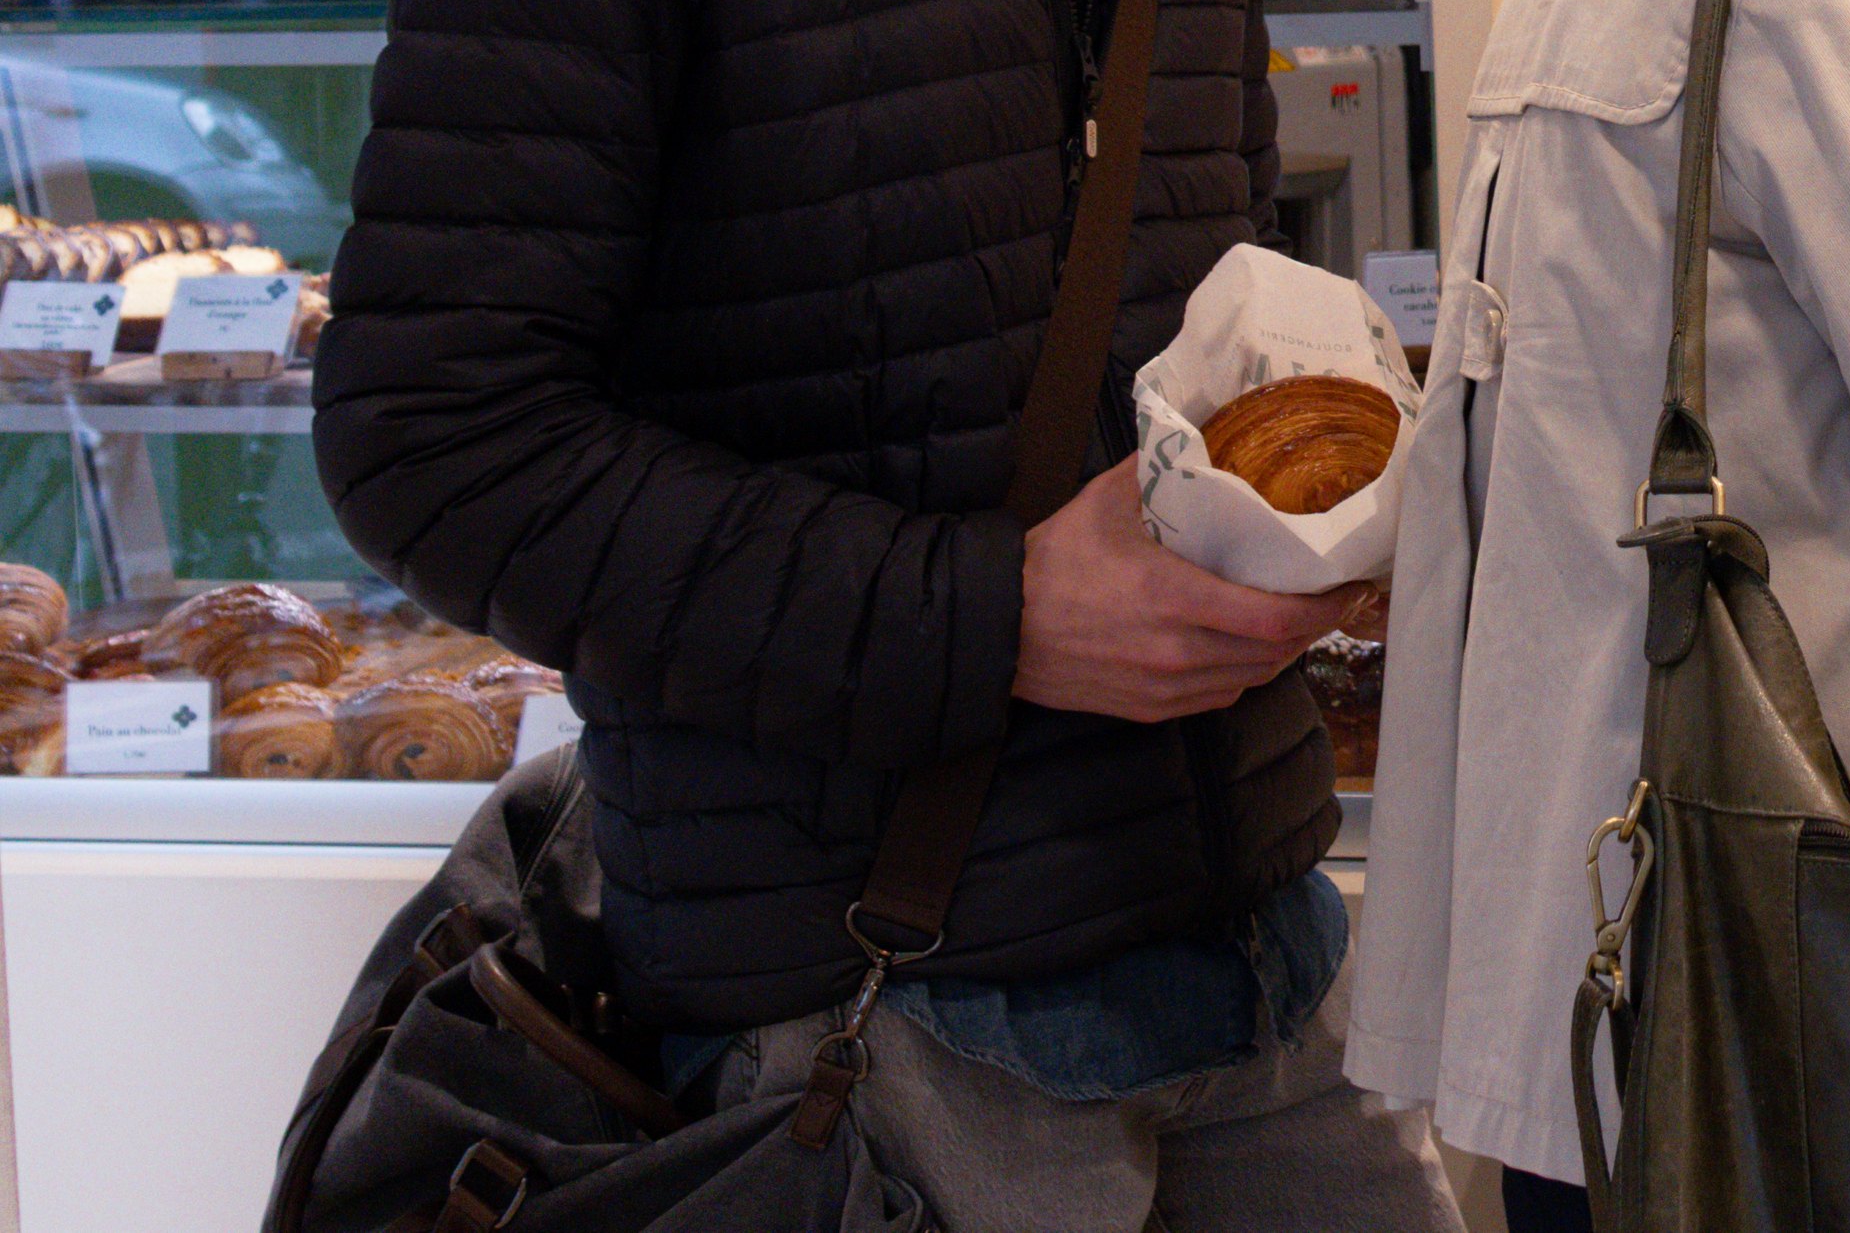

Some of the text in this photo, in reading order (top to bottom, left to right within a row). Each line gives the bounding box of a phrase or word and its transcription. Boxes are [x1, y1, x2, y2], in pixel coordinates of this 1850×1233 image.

[1389, 283, 1426, 296] Cookie
[88, 725, 113, 737] Pain
[133, 725, 182, 736] chocolat
